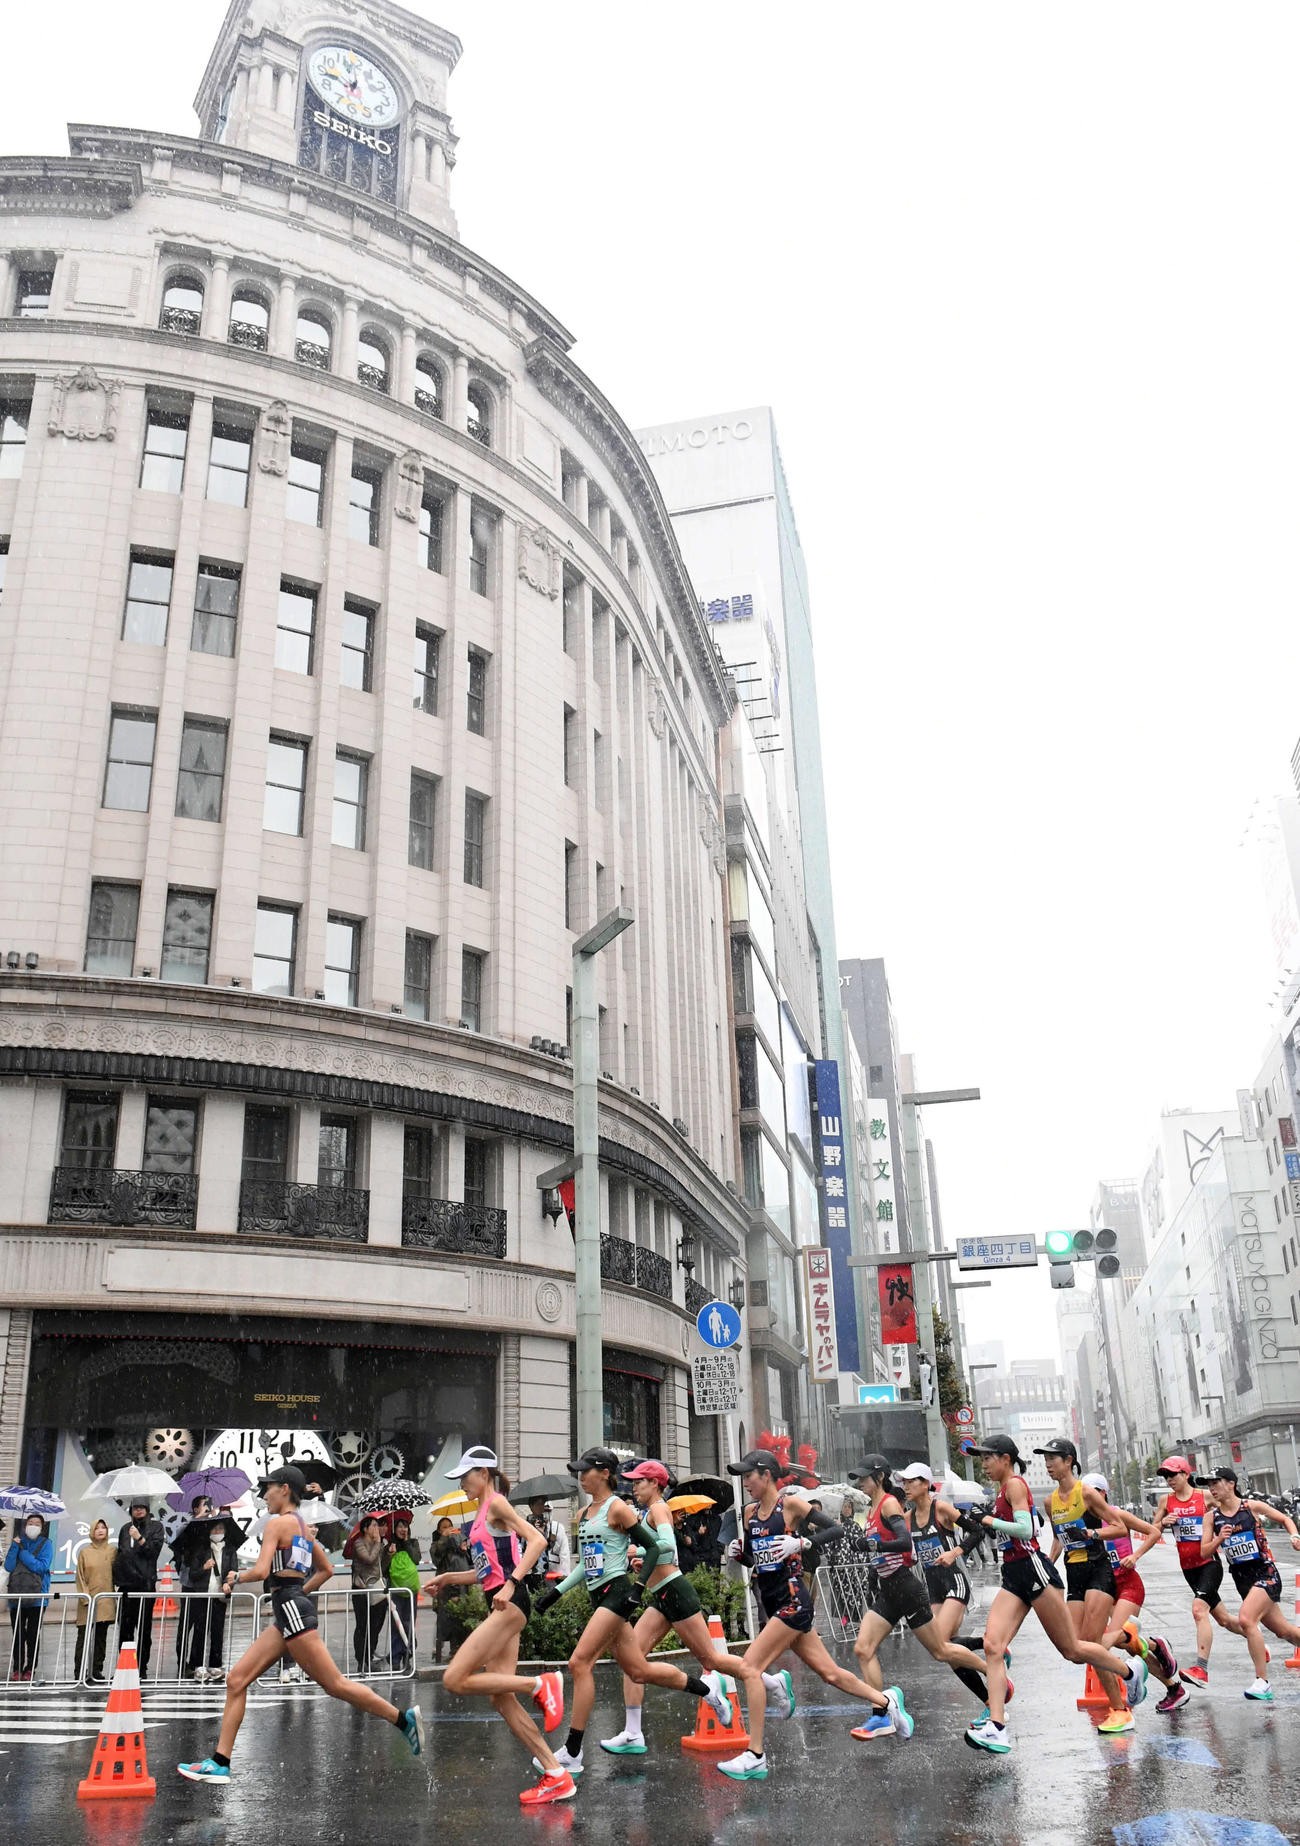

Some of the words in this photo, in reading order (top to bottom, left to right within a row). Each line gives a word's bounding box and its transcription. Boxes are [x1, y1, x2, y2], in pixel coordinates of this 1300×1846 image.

[322, 55, 335, 69] 10
[313, 111, 392, 155] SEIKO
[821, 1116, 847, 1228] 山野楽器
[869, 1118, 894, 1223] 教文館
[961, 1241, 1032, 1258] 銀座四丁目
[983, 1256, 1004, 1264] Ginza
[812, 1283, 835, 1373] キムラヤのパン
[254, 1393, 286, 1402] SEIKO
[287, 1394, 321, 1403] HOUSE
[239, 1431, 254, 1454] 11
[1183, 1517, 1197, 1525] Sky
[1180, 1526, 1196, 1536] ABE
[1231, 1535, 1247, 1545] Sky
